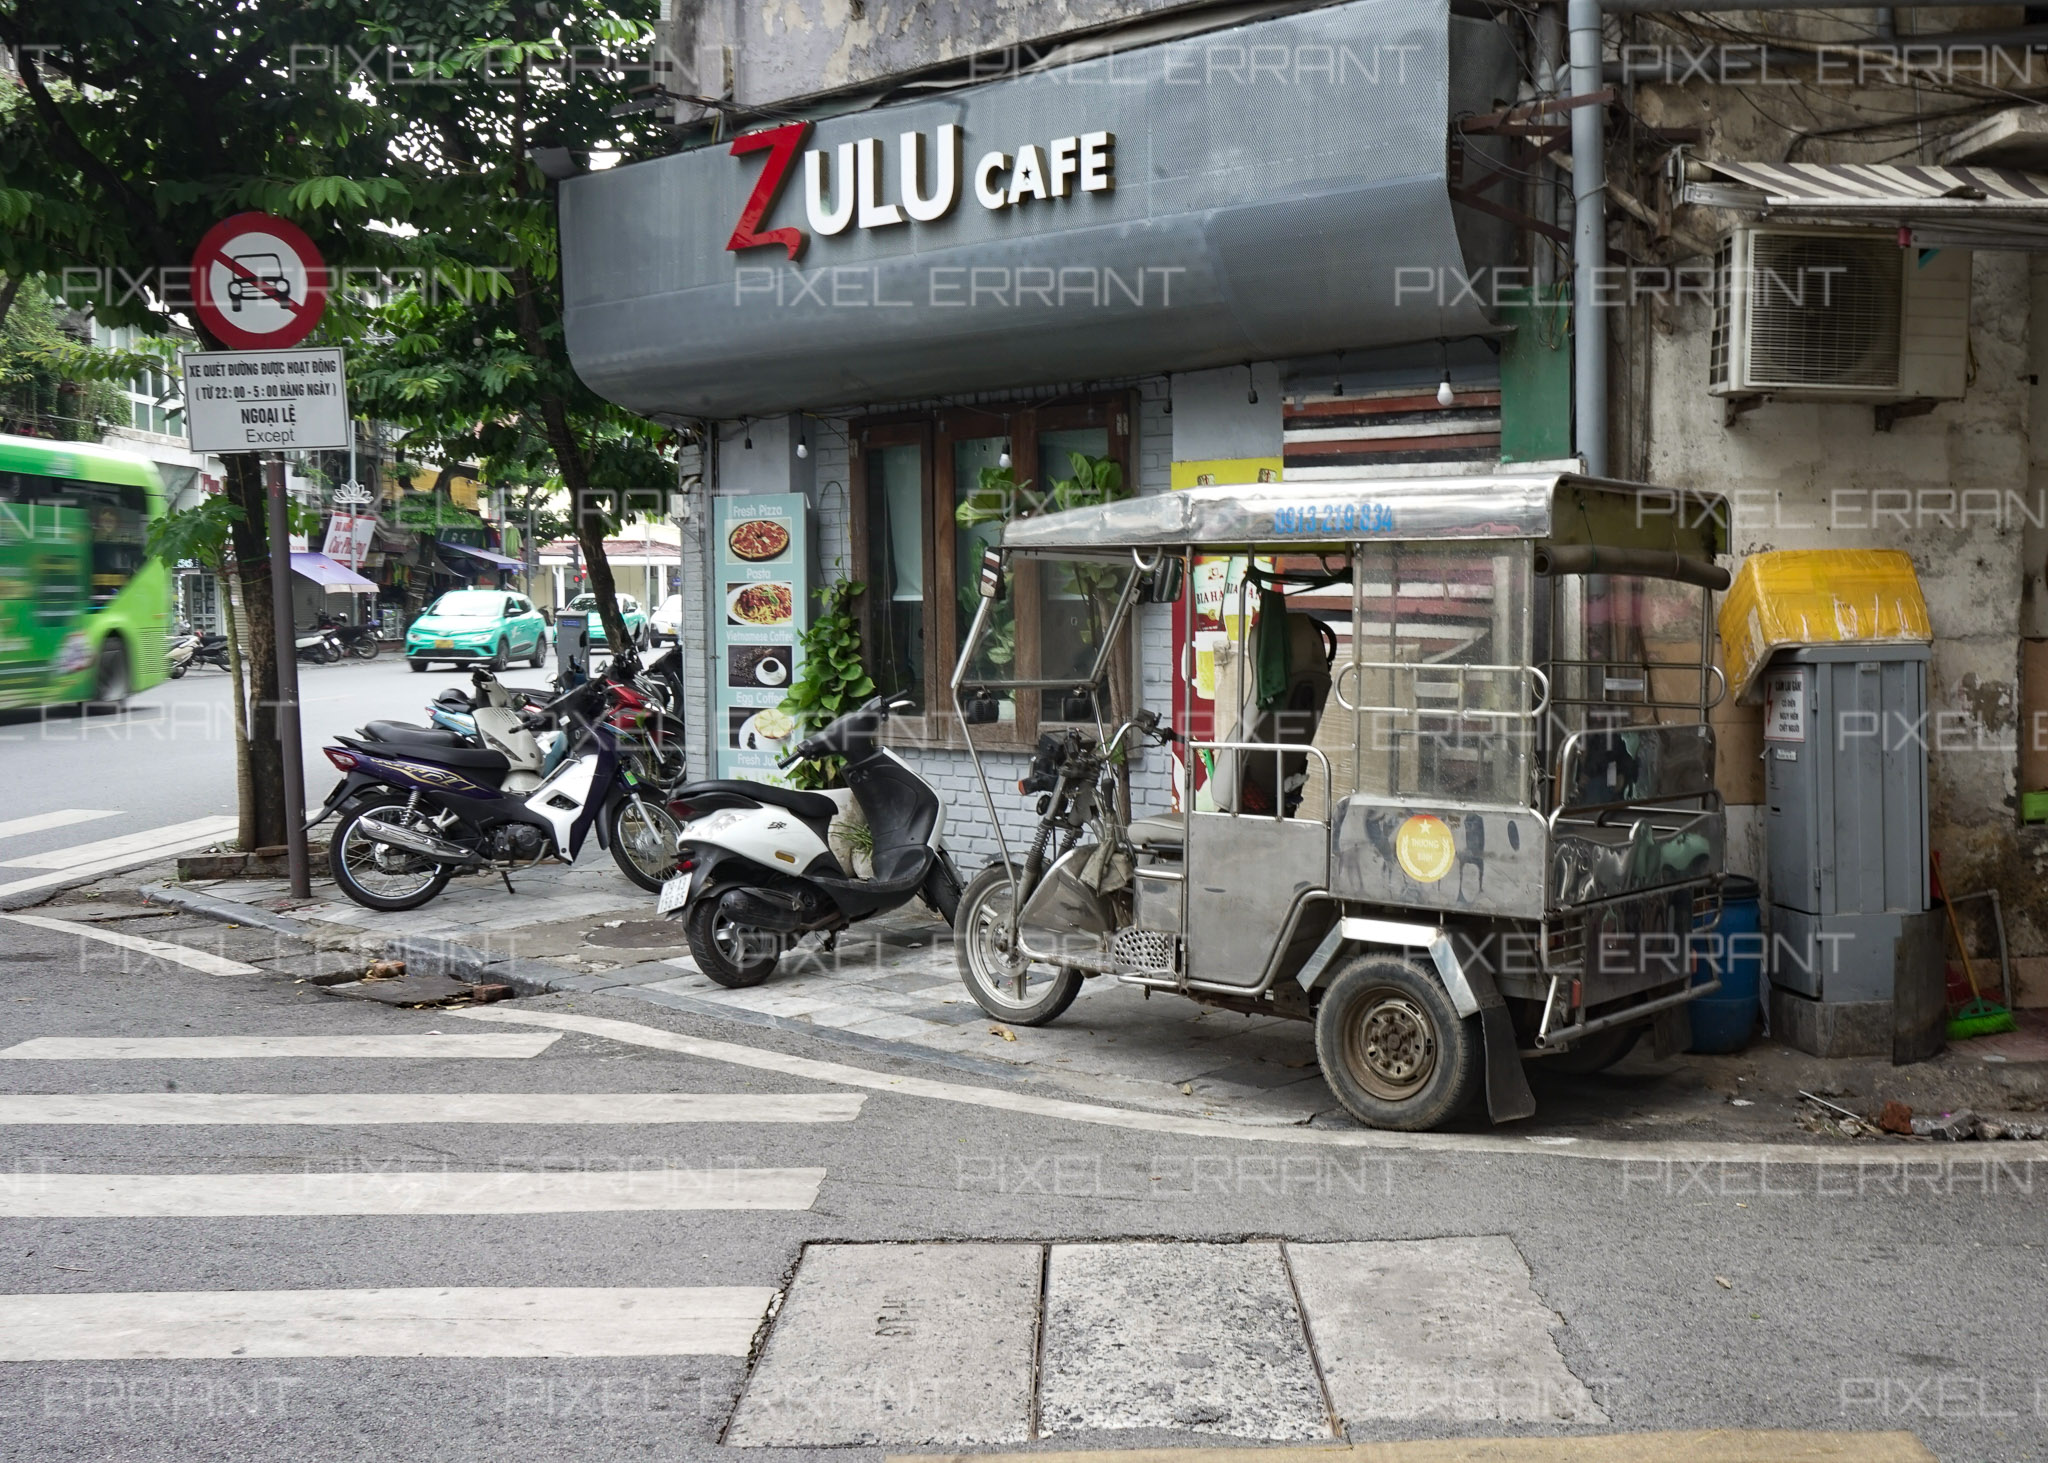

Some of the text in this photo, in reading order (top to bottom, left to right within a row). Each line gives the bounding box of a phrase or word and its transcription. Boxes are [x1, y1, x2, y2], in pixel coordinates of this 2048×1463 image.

[726, 120, 1115, 261] ZULU CAFE
[189, 365, 200, 377] XE
[288, 361, 309, 377] HOẠT
[313, 358, 336, 375] ĐỘNG
[280, 381, 304, 397] HÀNG
[241, 403, 297, 427] NGOẠI LỆ
[246, 428, 296, 445] Except
[733, 503, 783, 517] Fresh Pizza
[1275, 506, 1317, 534] 0913
[1321, 503, 1354, 532] 219
[1360, 503, 1393, 532] 834
[746, 567, 772, 580] Pasta
[1226, 583, 1239, 595] BIA
[1196, 592, 1210, 605] BIA
[726, 630, 793, 642] Vietnamese Coffee
[736, 692, 753, 706] Egg
[737, 753, 761, 766] Fresh
